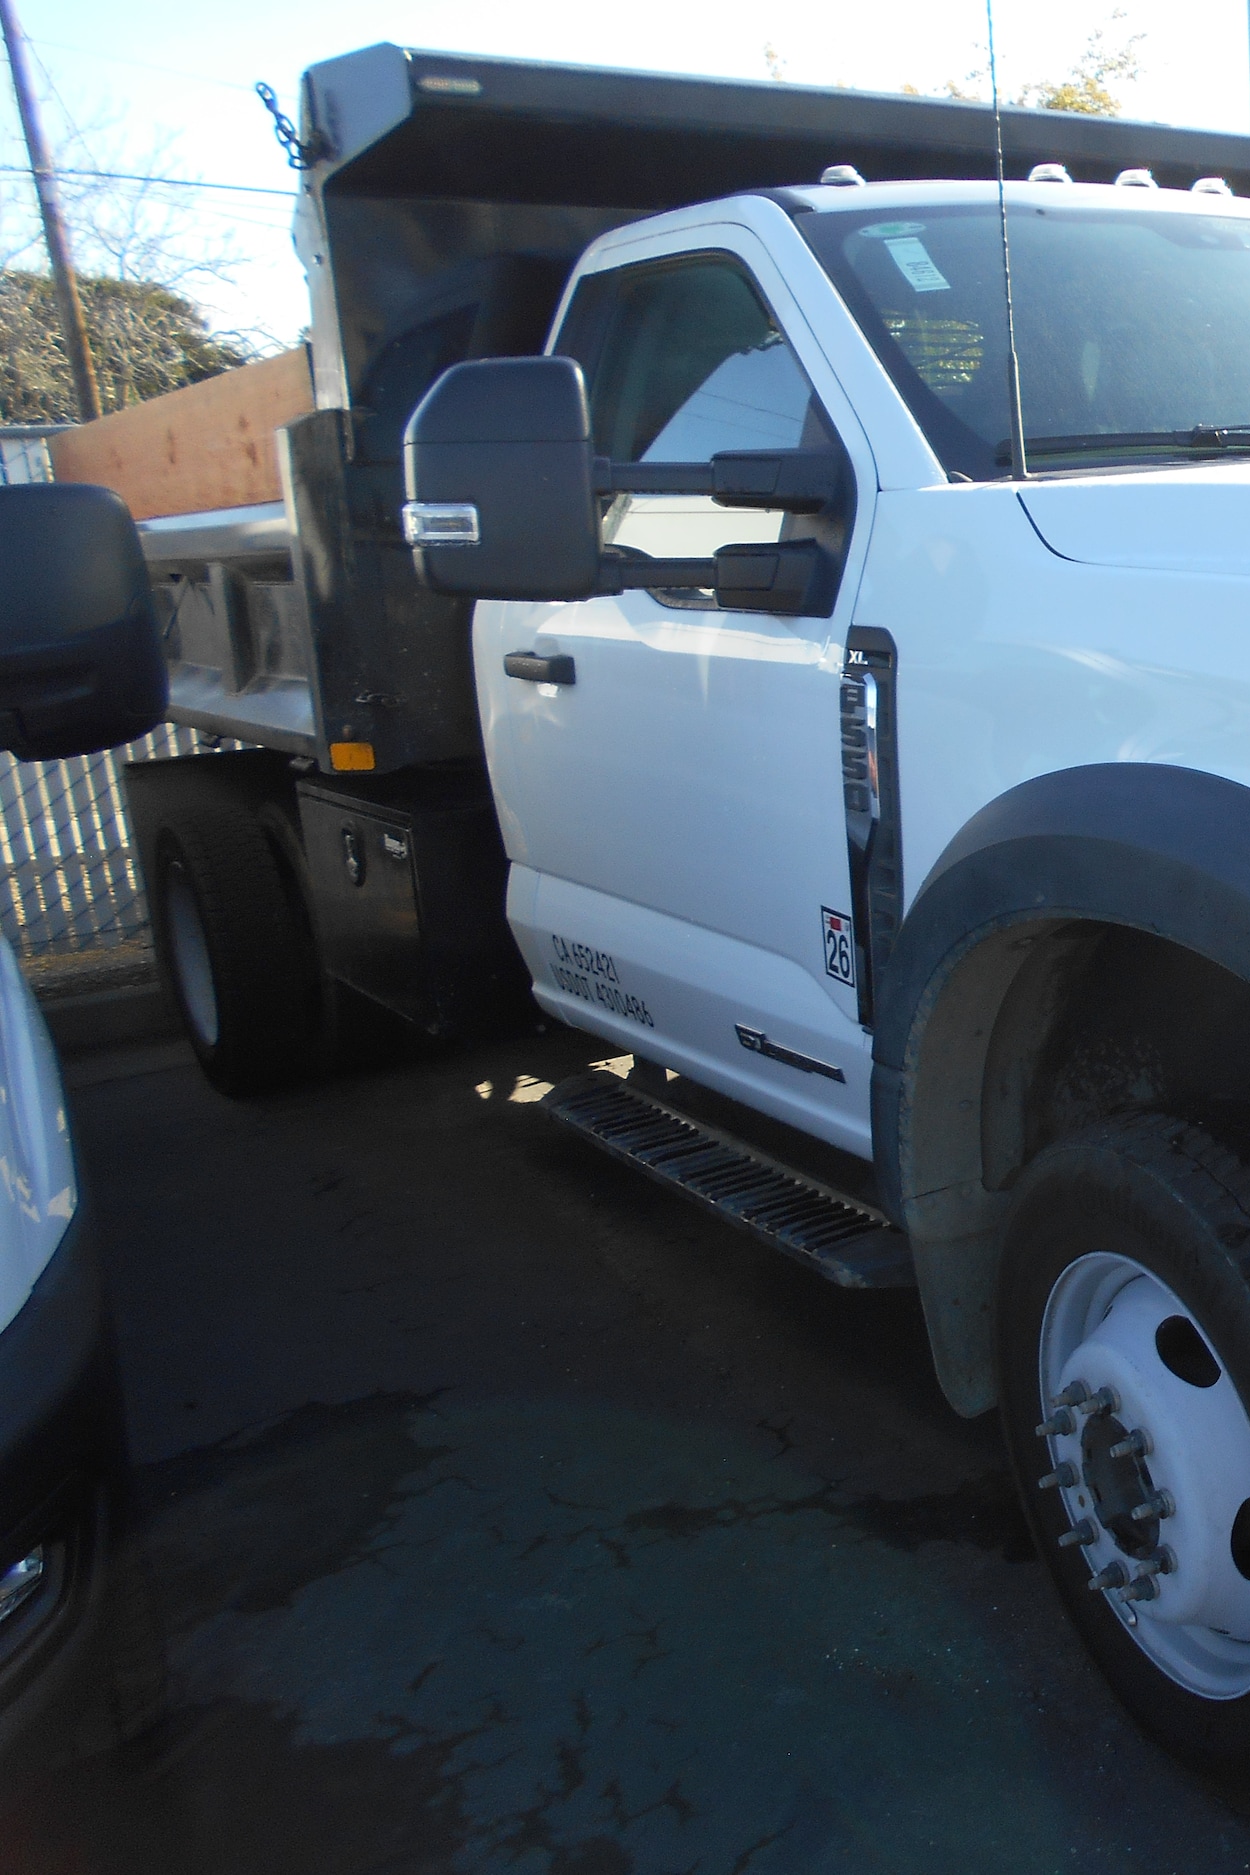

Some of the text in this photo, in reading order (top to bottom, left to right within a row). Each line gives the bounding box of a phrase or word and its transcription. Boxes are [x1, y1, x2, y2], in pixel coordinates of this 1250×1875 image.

[848, 649, 869, 666] XL
[552, 934, 621, 985] CA 652421
[827, 929, 851, 979] 26
[549, 962, 655, 1028] USDOT 4310486
